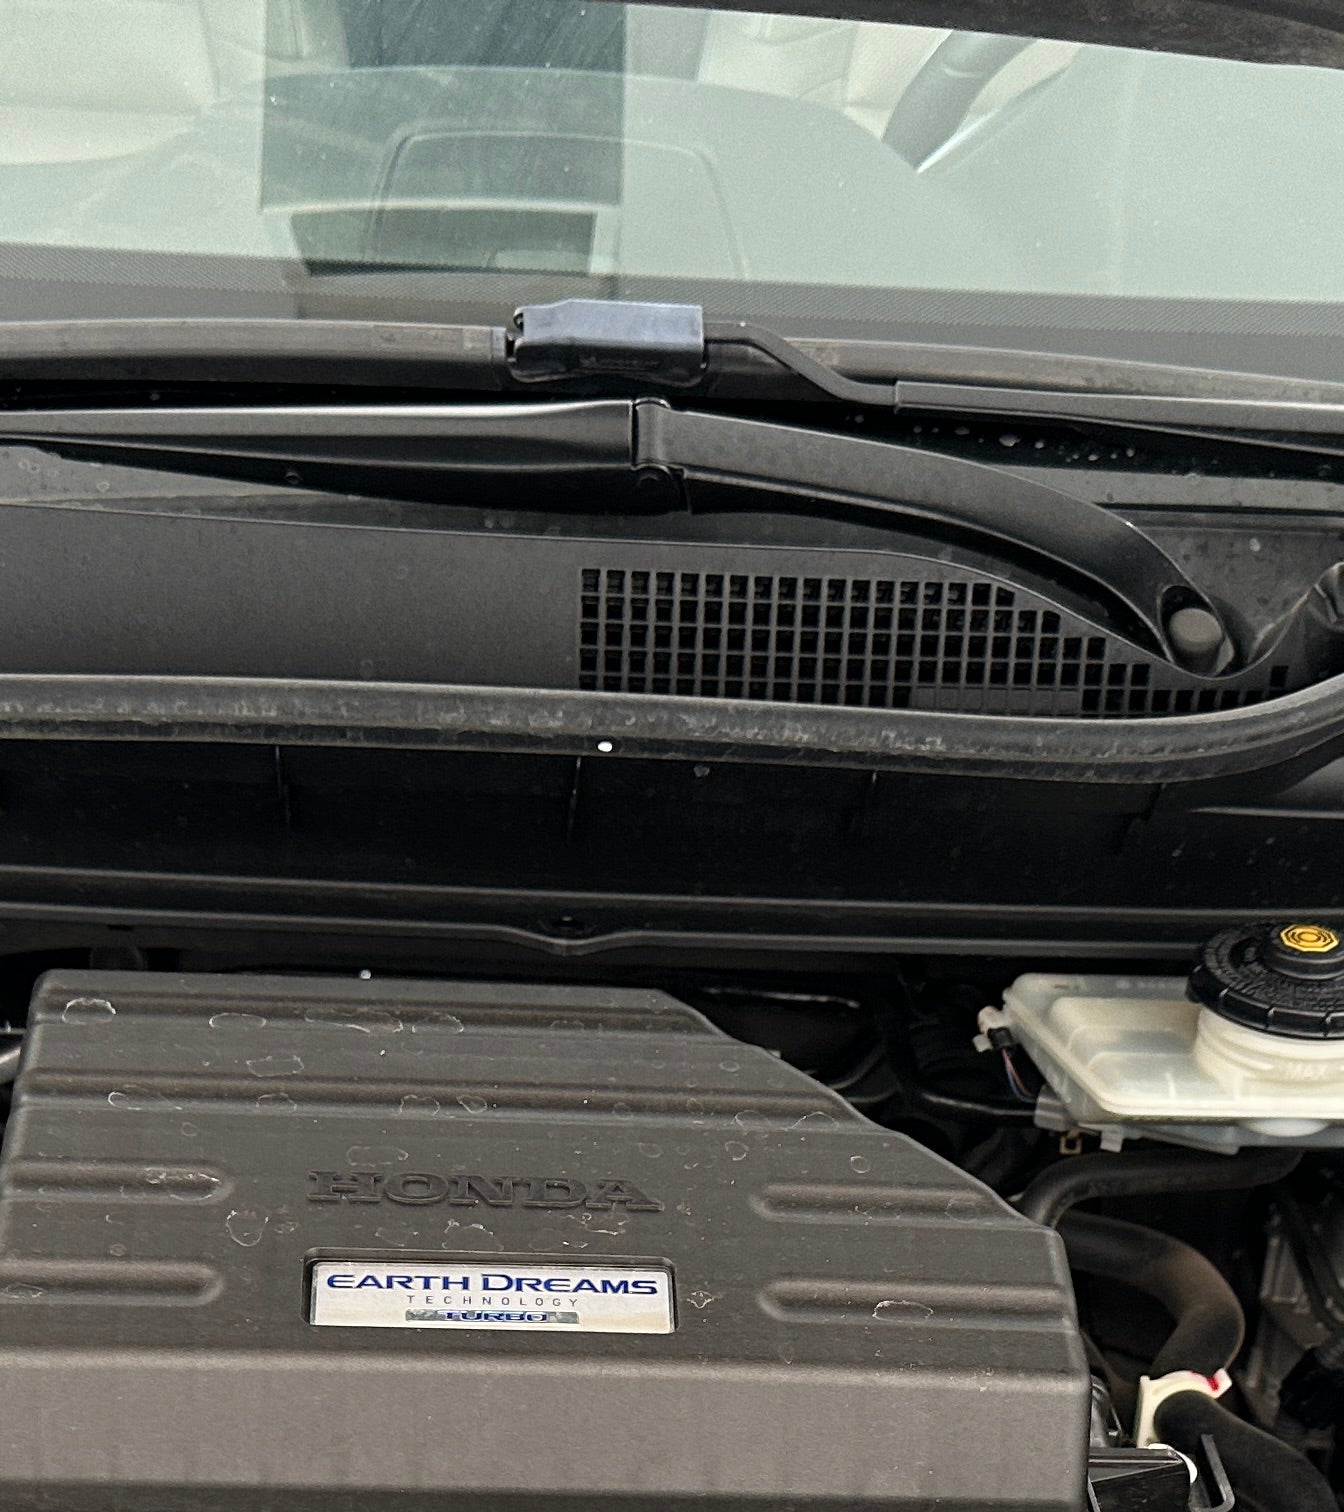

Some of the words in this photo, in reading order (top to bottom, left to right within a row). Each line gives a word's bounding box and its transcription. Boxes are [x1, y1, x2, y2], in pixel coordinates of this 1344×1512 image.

[307, 1170, 664, 1213] HONDA
[326, 1273, 470, 1293] EARTH
[481, 1273, 658, 1296] DREAMS
[407, 1294, 578, 1308] TECHNOLOGY
[443, 1310, 548, 1323] TURBO
